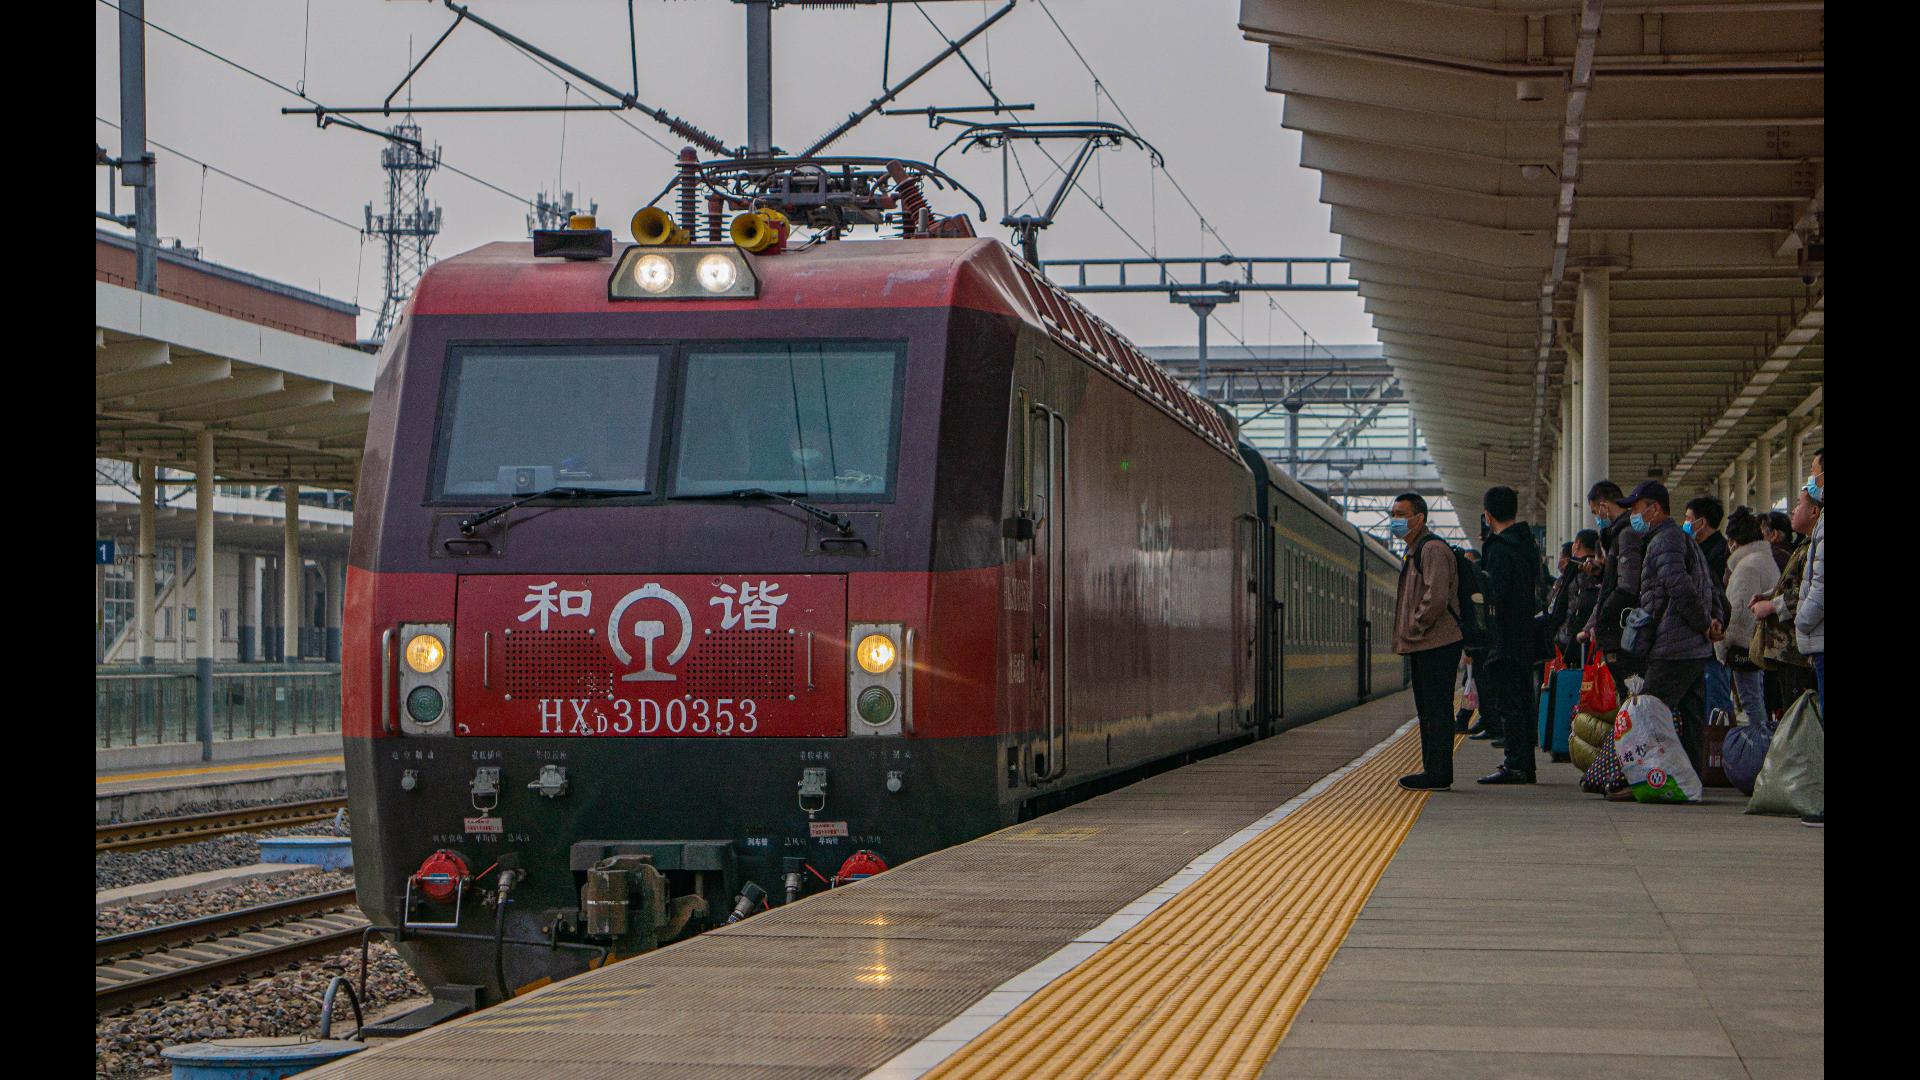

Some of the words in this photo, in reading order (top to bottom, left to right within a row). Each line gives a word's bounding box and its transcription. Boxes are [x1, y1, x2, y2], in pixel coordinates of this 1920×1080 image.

[99, 543, 106, 561] 1
[518, 580, 592, 632] 和
[709, 580, 789, 631] 谐
[539, 698, 758, 734] HXD3D0353
